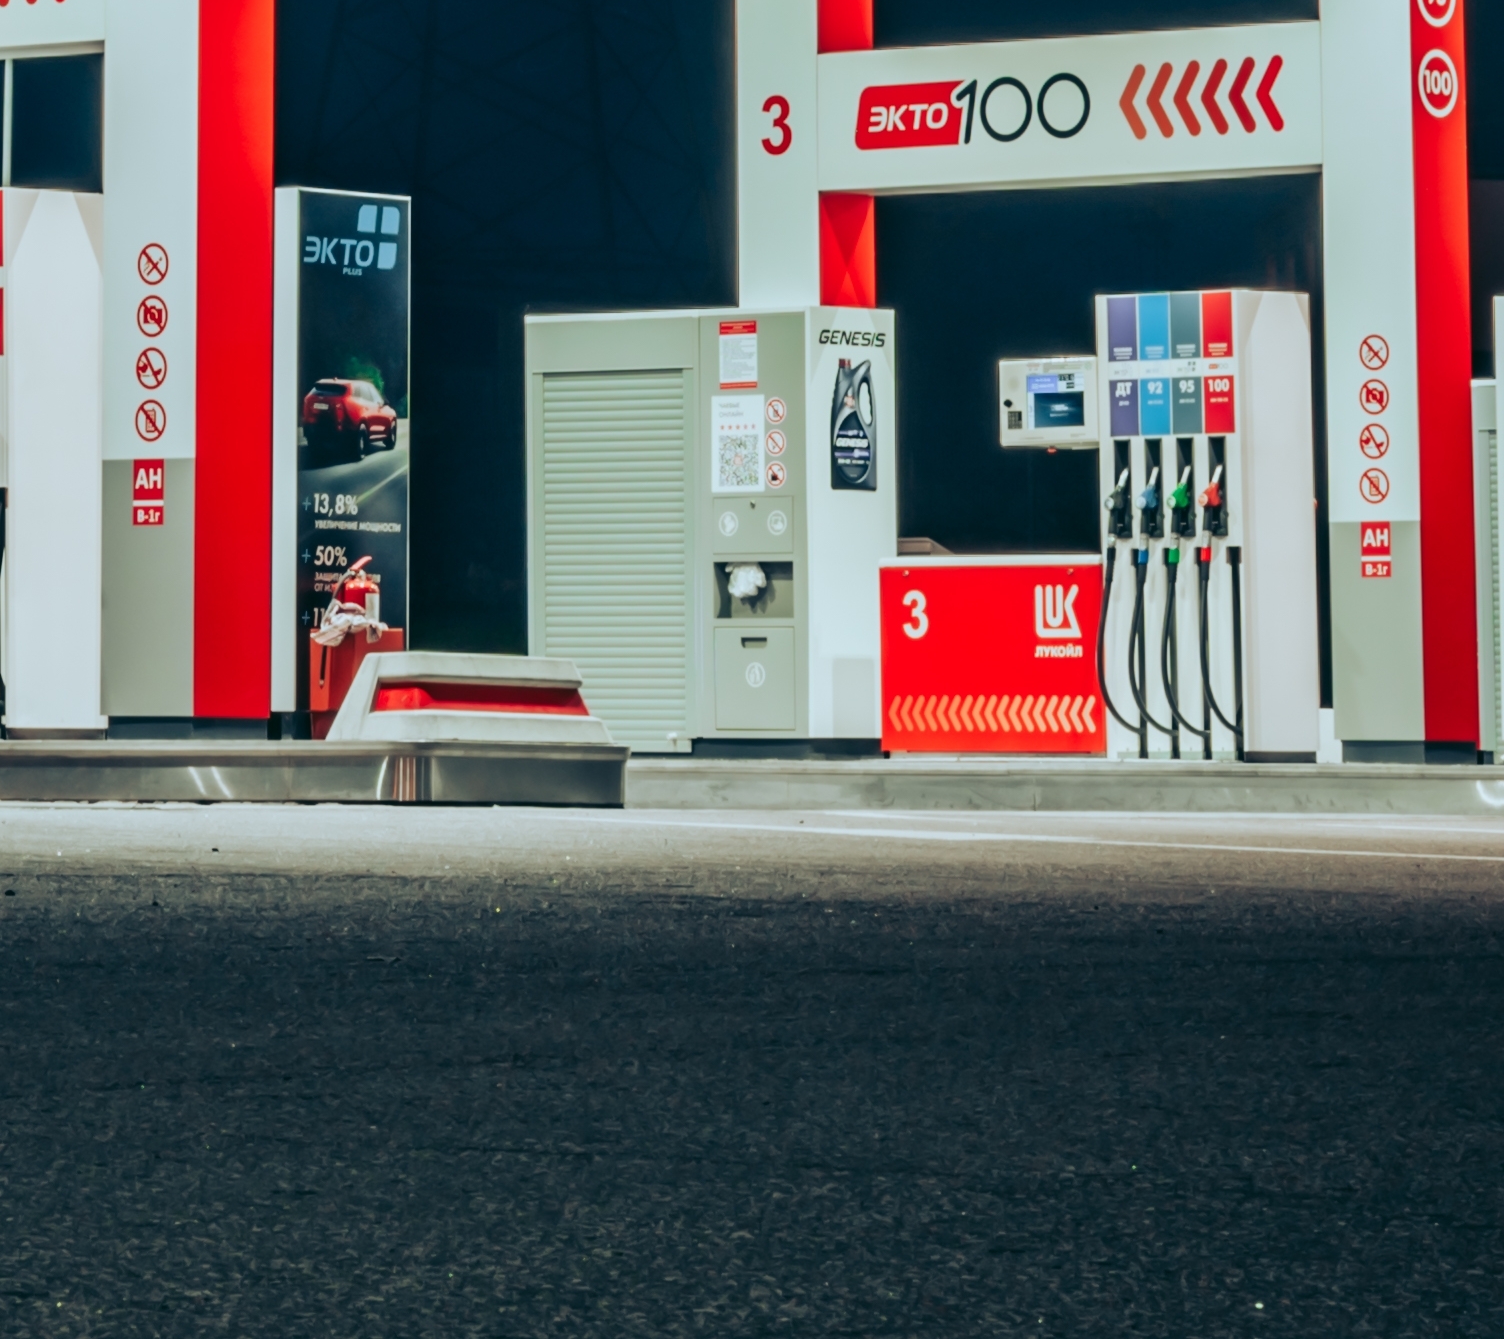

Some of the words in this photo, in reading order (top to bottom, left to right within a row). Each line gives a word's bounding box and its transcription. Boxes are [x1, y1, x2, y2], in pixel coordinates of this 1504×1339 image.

[1423, 68, 1453, 97] 100
[761, 94, 793, 156] 3
[303, 235, 375, 268] ЭКТО
[342, 267, 363, 276] PLUS
[818, 329, 886, 348] GENESIS
[1116, 381, 1132, 397] ДТ
[1147, 381, 1163, 394] 92
[1179, 380, 1195, 393] 95
[1208, 379, 1229, 392] 100
[902, 590, 929, 639] 3
[1034, 644, 1083, 658] ЛУКОЙЛ
